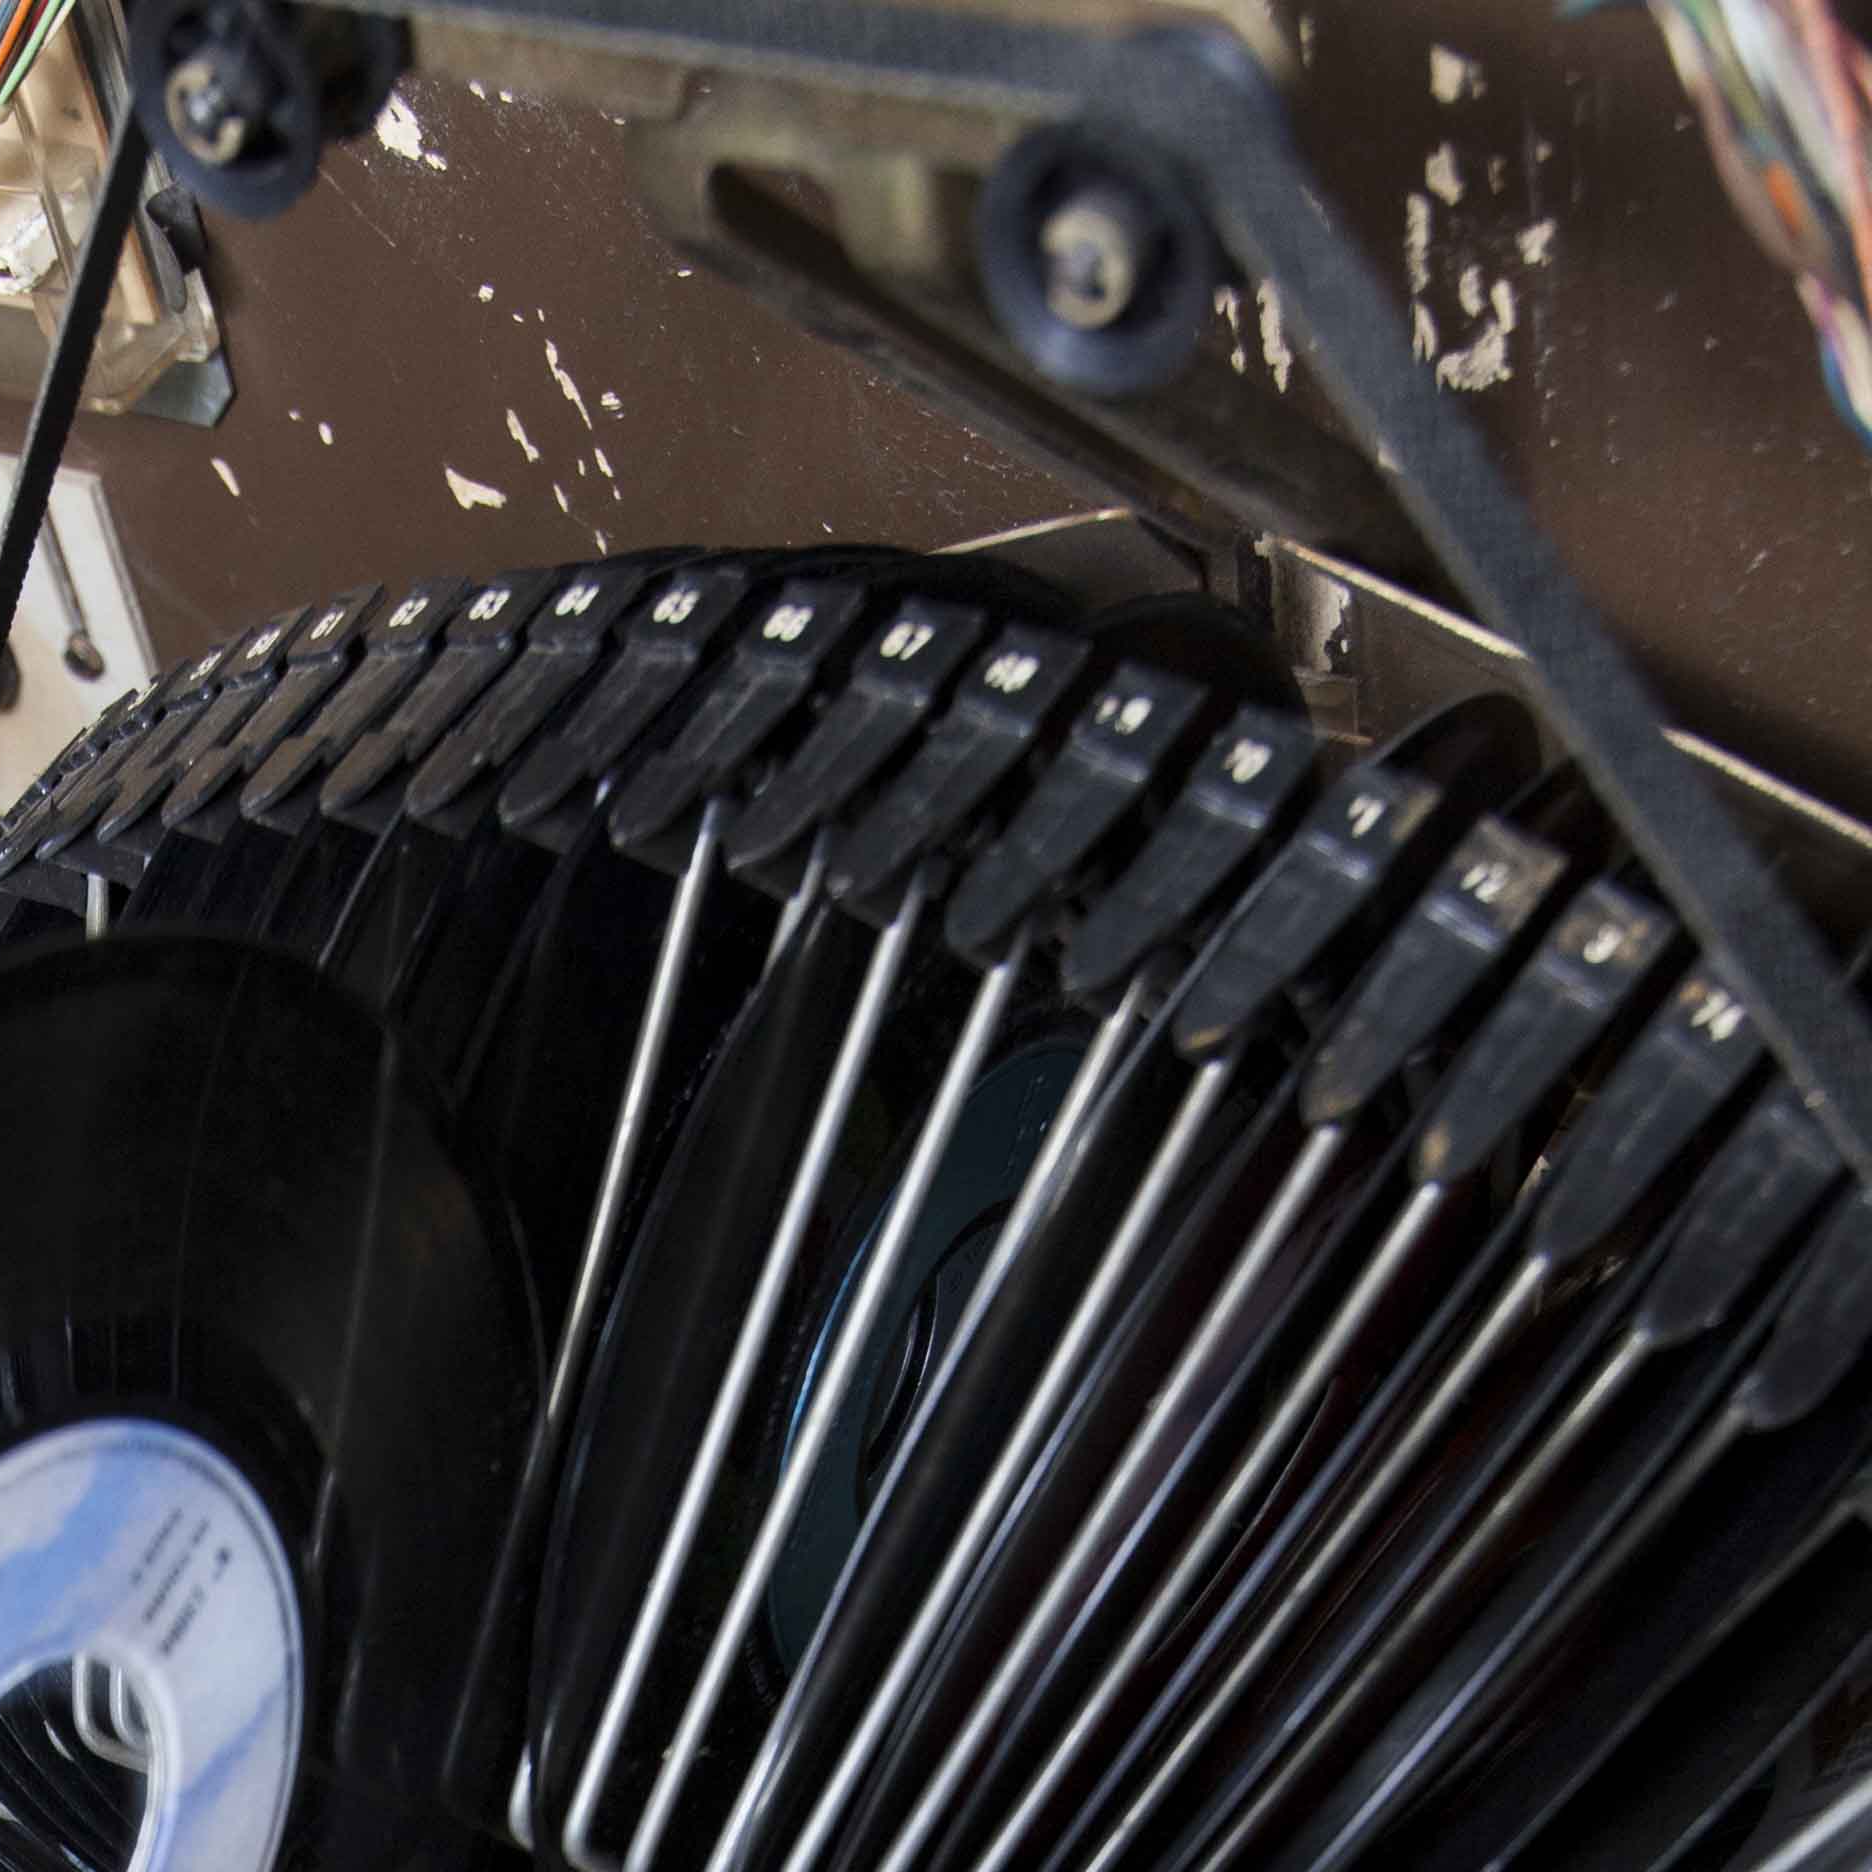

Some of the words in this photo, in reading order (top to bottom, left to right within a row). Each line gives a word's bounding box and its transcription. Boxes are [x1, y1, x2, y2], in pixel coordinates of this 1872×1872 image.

[389, 597, 429, 629] 62
[468, 589, 510, 620] 63
[555, 584, 599, 616] 64
[653, 589, 699, 624] 65
[310, 608, 346, 640] 61
[763, 604, 813, 642] 66
[880, 621, 935, 661] 67
